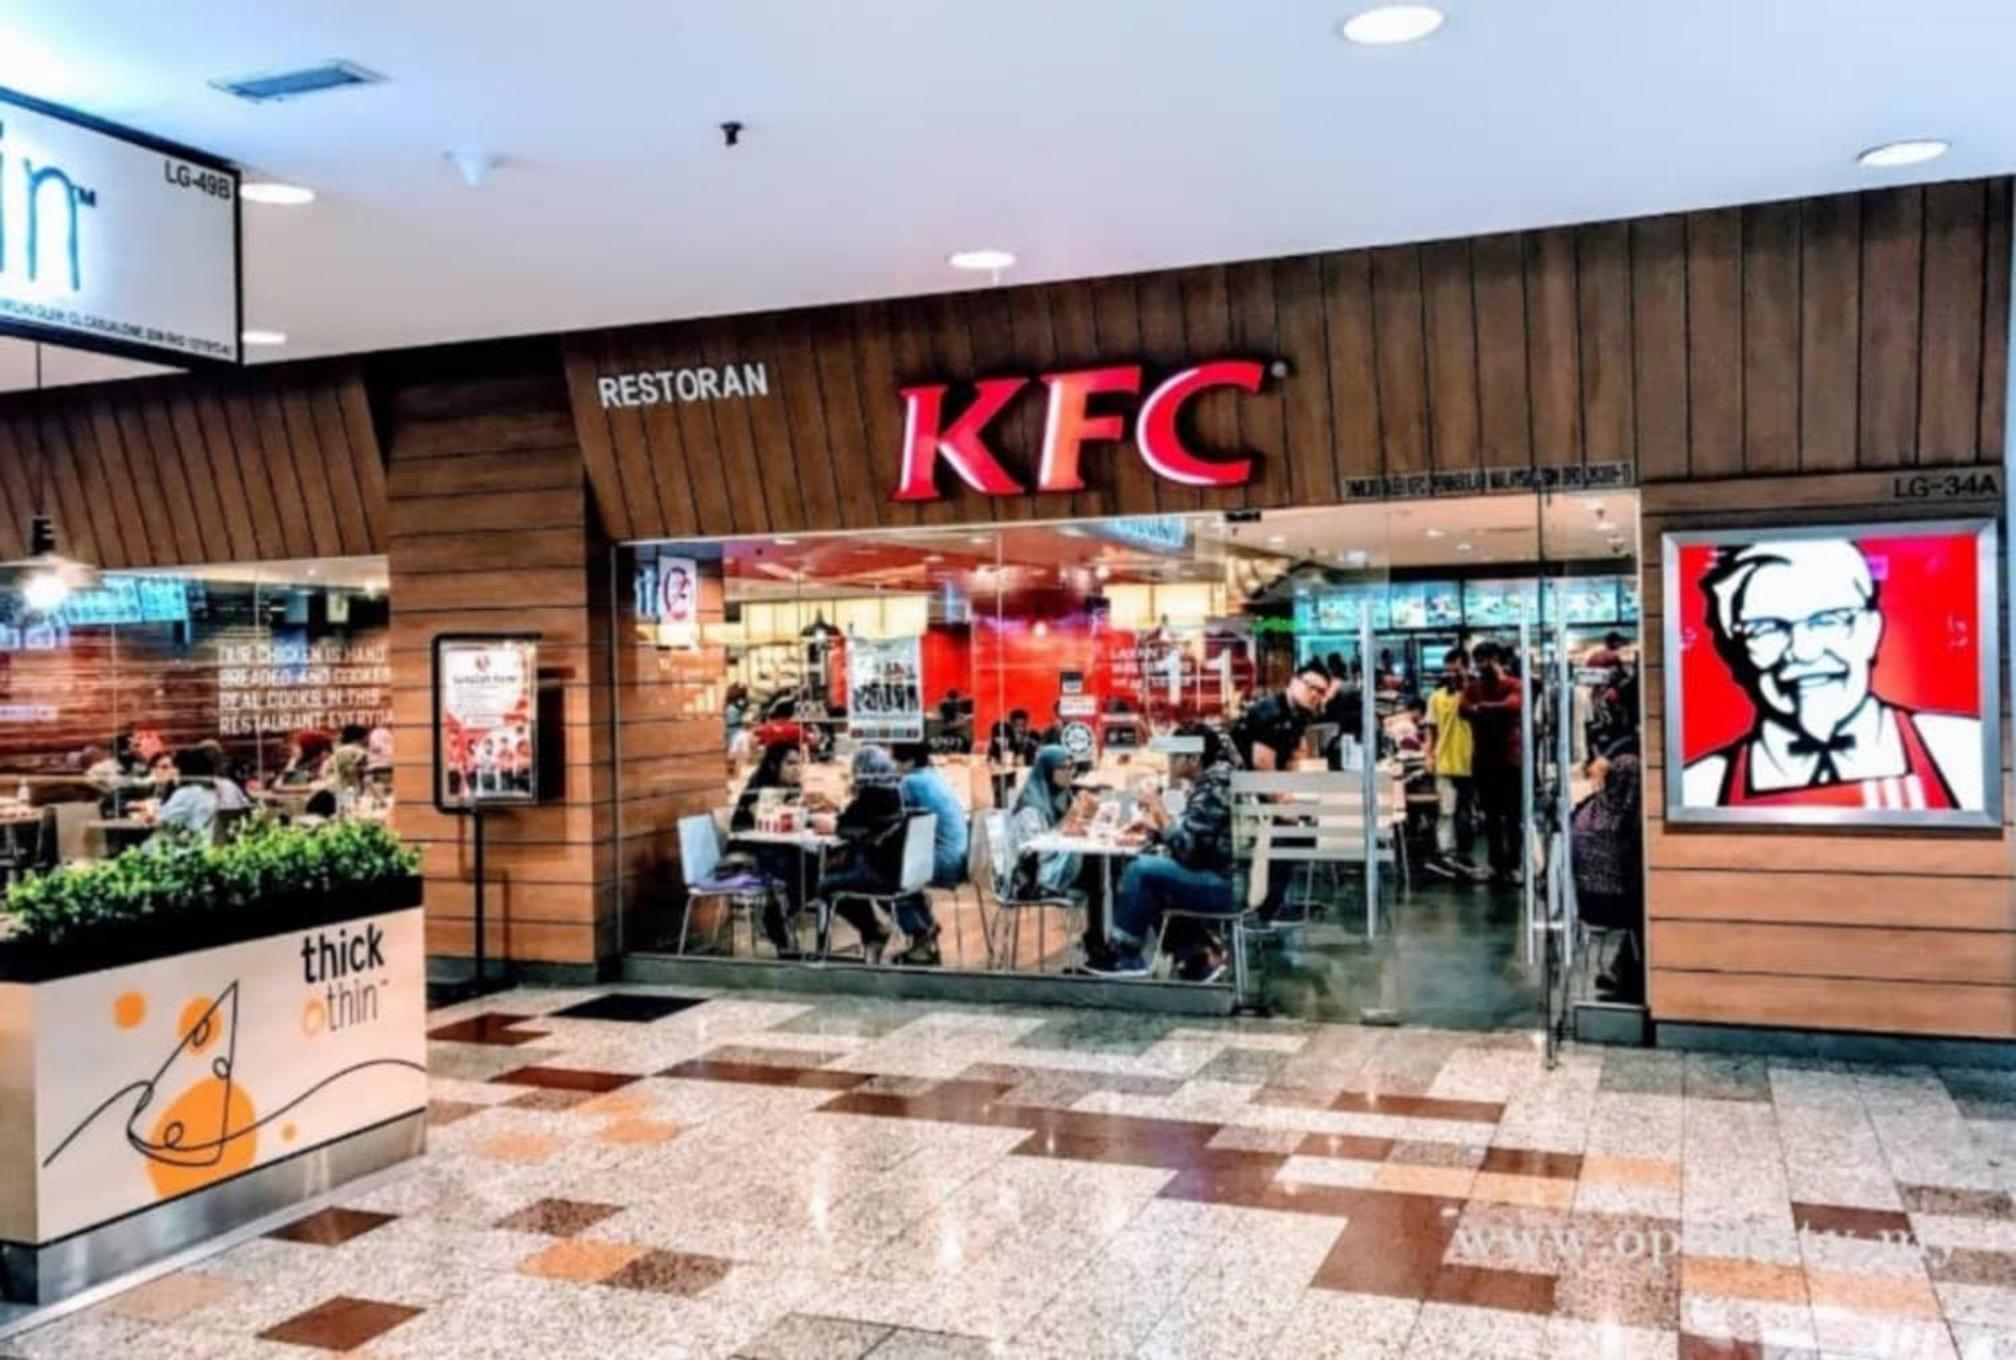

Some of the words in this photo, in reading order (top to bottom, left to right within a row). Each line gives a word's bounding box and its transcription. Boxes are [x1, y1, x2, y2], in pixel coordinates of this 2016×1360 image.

[164, 160, 231, 200] LG-49B
[598, 361, 769, 408] RESTORAN
[890, 359, 1265, 500] KFC
[1894, 472, 1998, 498] LG-34A
[219, 712, 325, 737] RESTAURANT
[300, 923, 384, 984] thick
[327, 979, 378, 1032] thin
